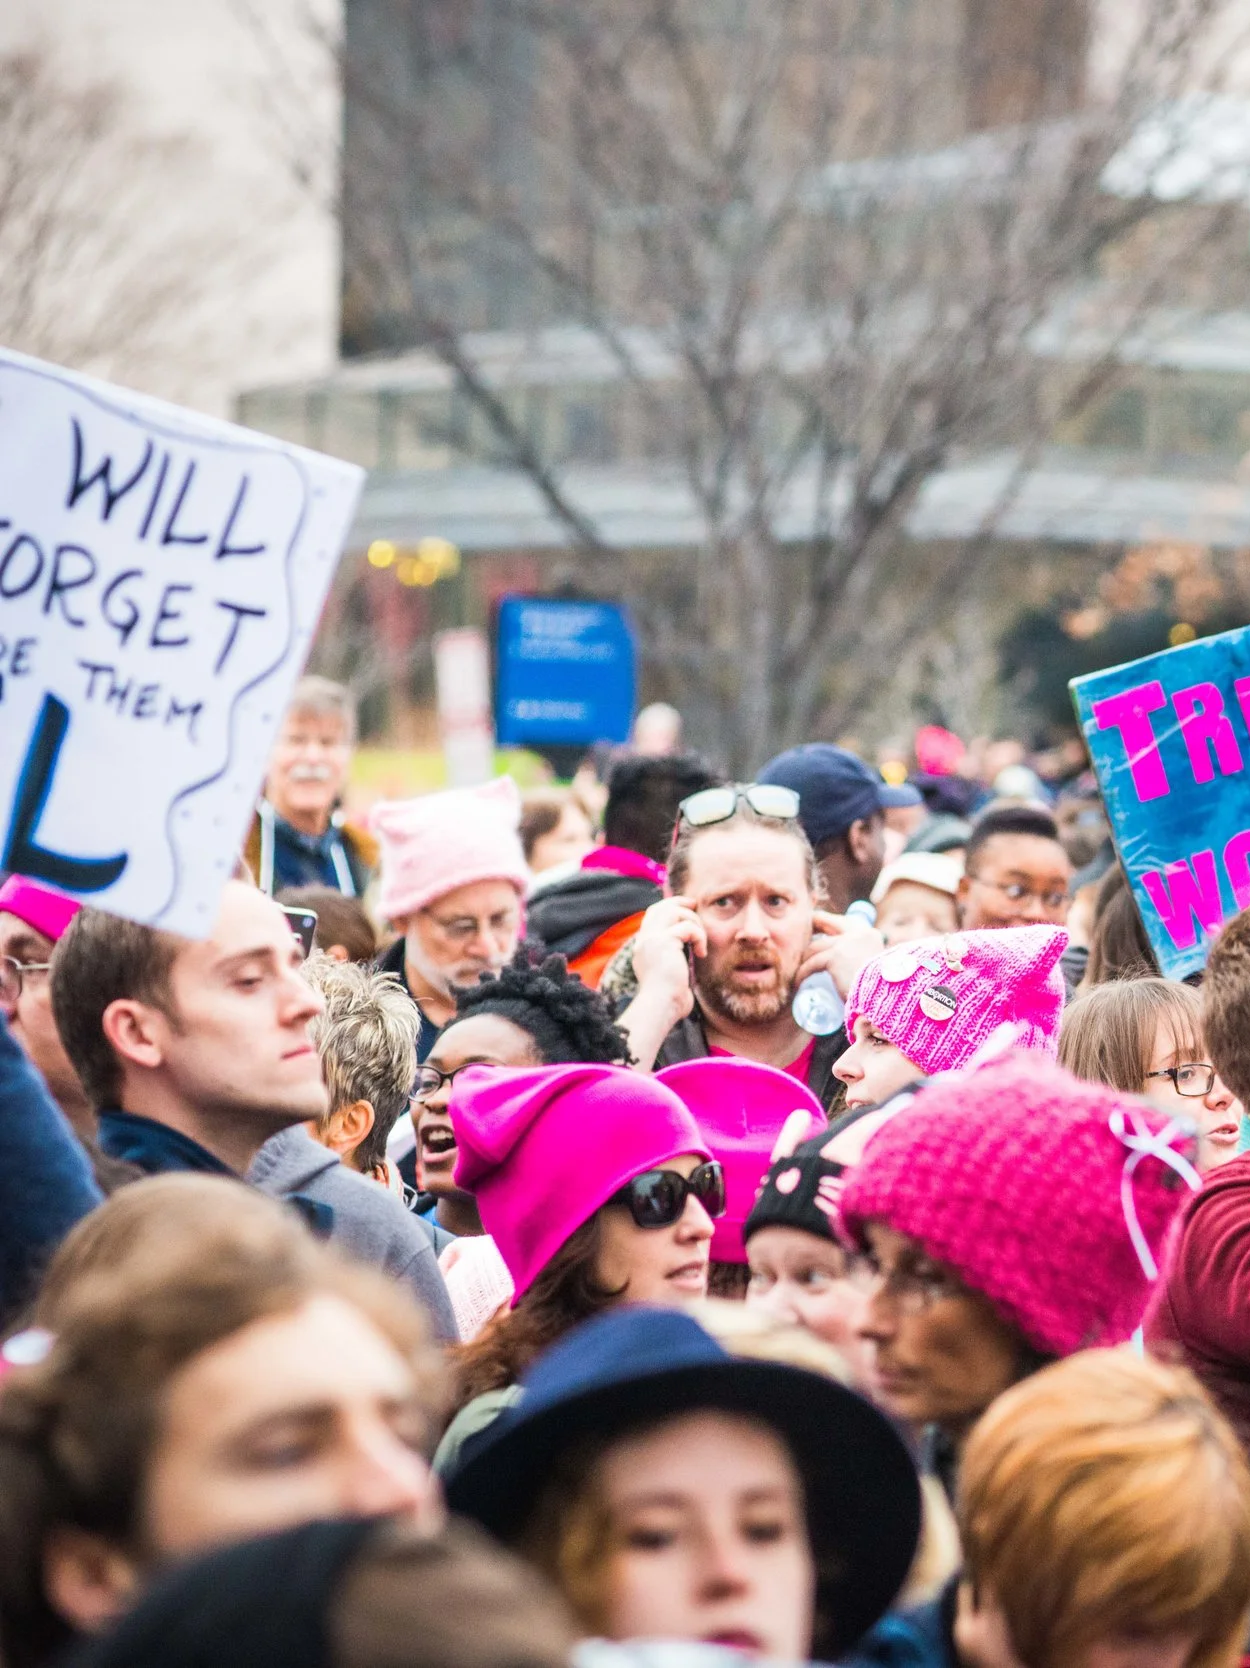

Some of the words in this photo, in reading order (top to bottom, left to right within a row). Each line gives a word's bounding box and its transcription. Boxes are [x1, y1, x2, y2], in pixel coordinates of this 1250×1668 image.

[66, 414, 267, 559] WILL
[0, 519, 267, 676] ORGET
[77, 658, 204, 745] THEM
